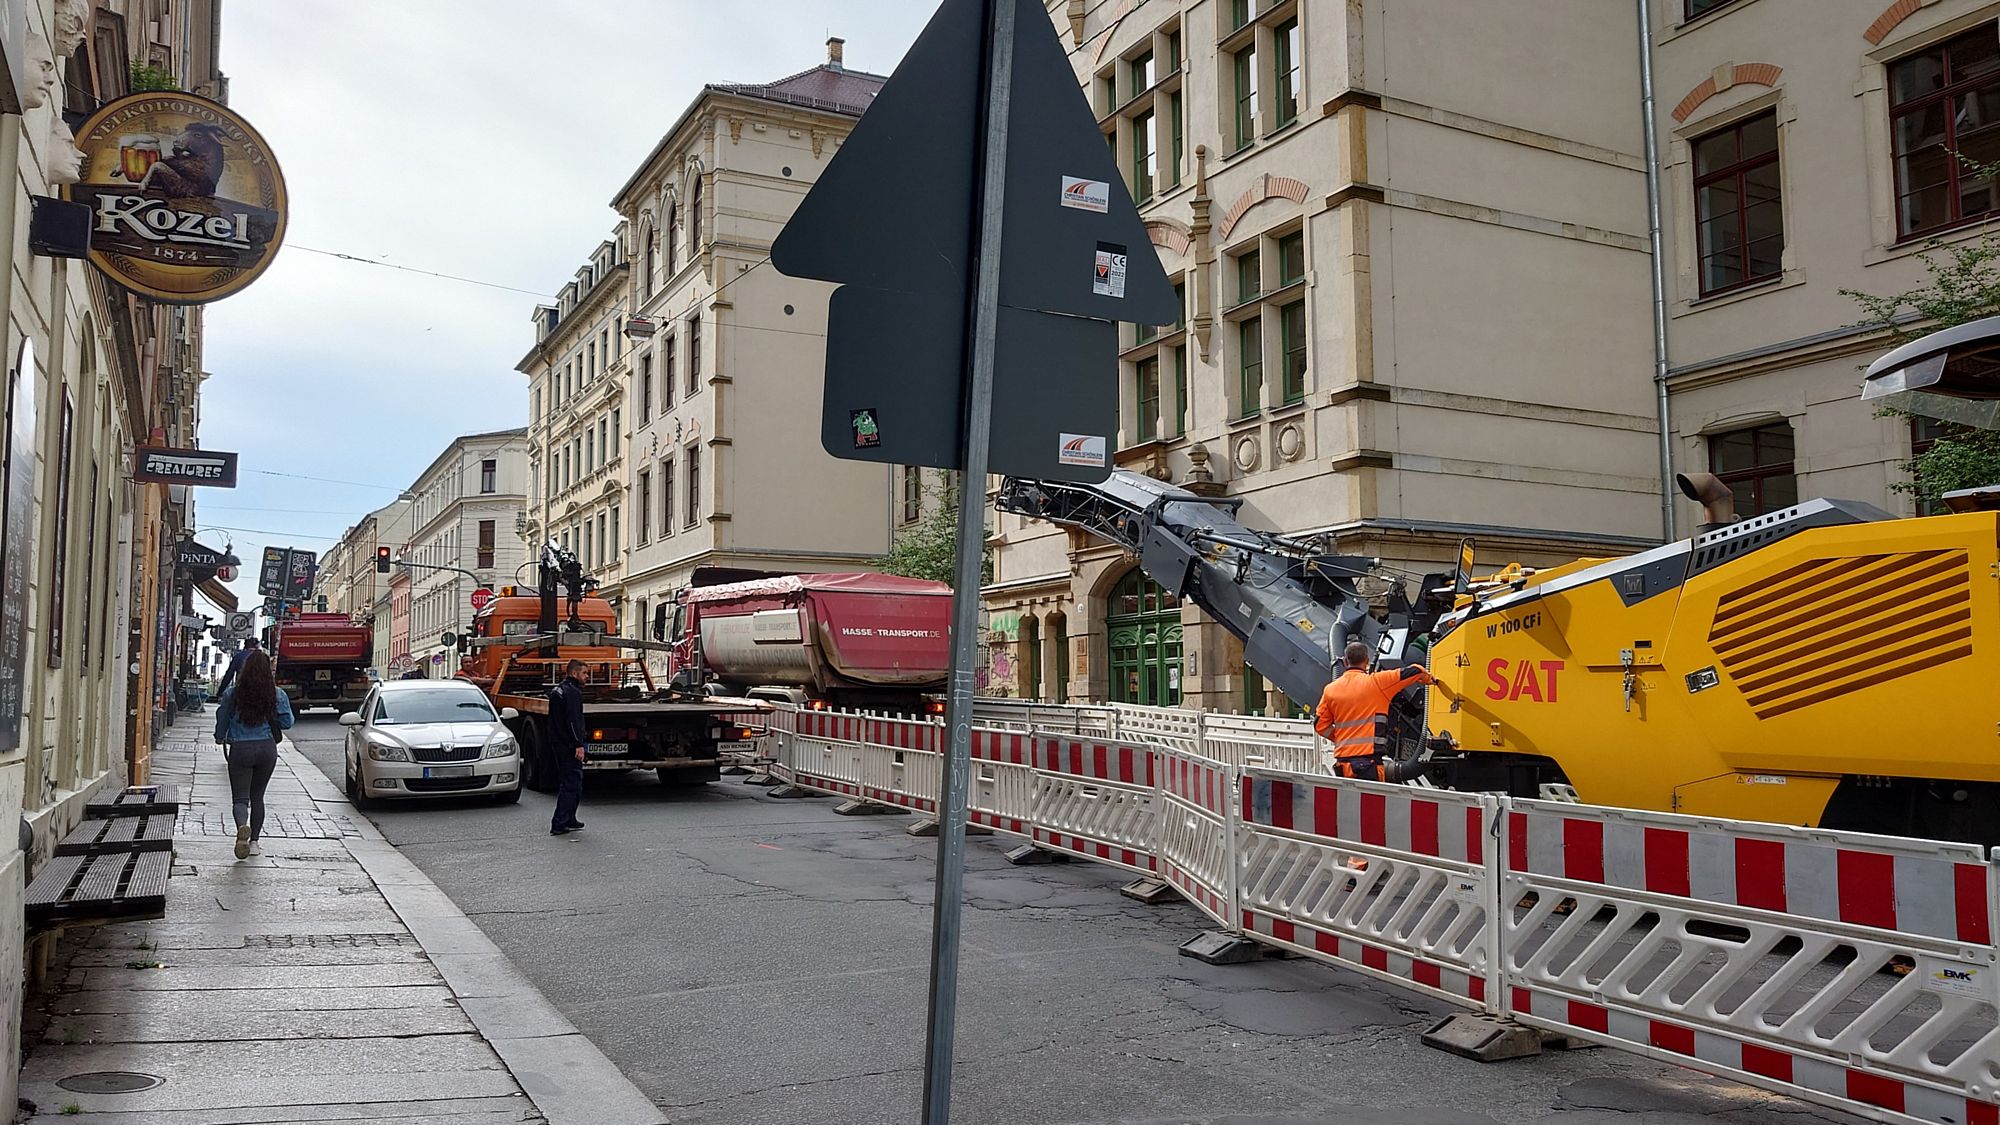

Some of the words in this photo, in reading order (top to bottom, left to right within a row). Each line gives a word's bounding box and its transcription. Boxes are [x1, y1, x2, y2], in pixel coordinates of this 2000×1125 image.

[94, 193, 250, 244] Kozel
[153, 247, 199, 261] 1874
[146, 455, 225, 478] CREATURES
[472, 594, 488, 605] STO
[1486, 624, 1498, 638] W
[1500, 618, 1521, 635] 100
[319, 671, 328, 680] A
[1485, 657, 1565, 703] SAT
[1943, 968, 1972, 981] BMK
